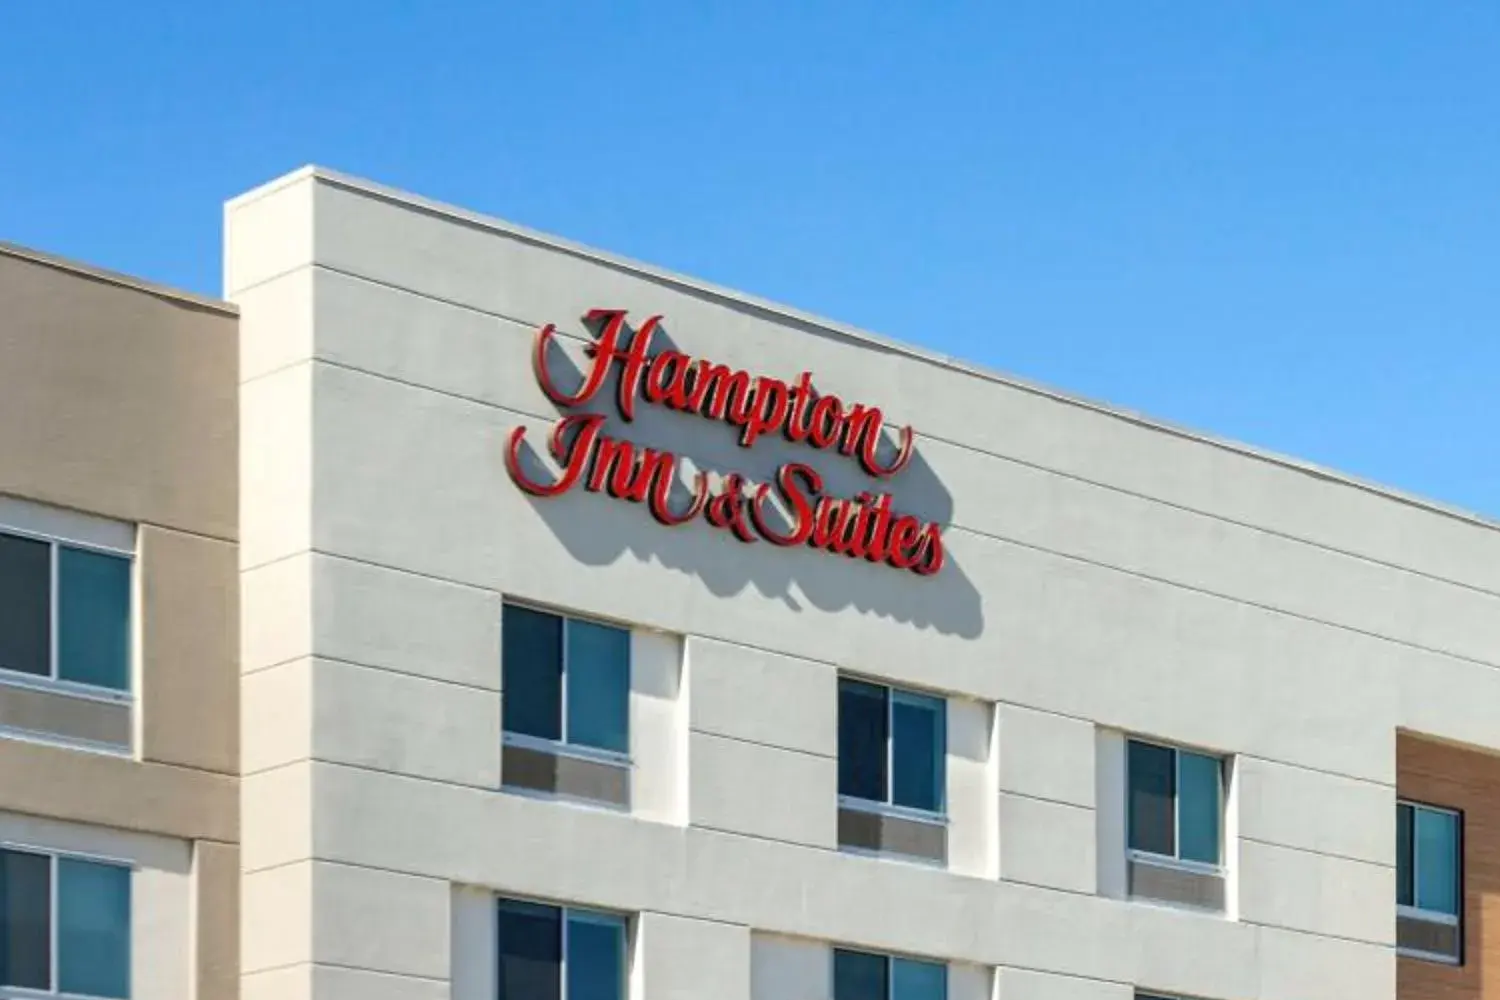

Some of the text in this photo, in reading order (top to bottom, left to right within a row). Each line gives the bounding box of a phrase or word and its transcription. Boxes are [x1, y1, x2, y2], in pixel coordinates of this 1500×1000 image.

[532, 308, 915, 478] Hampton
[504, 413, 945, 576] Inn & Suites
